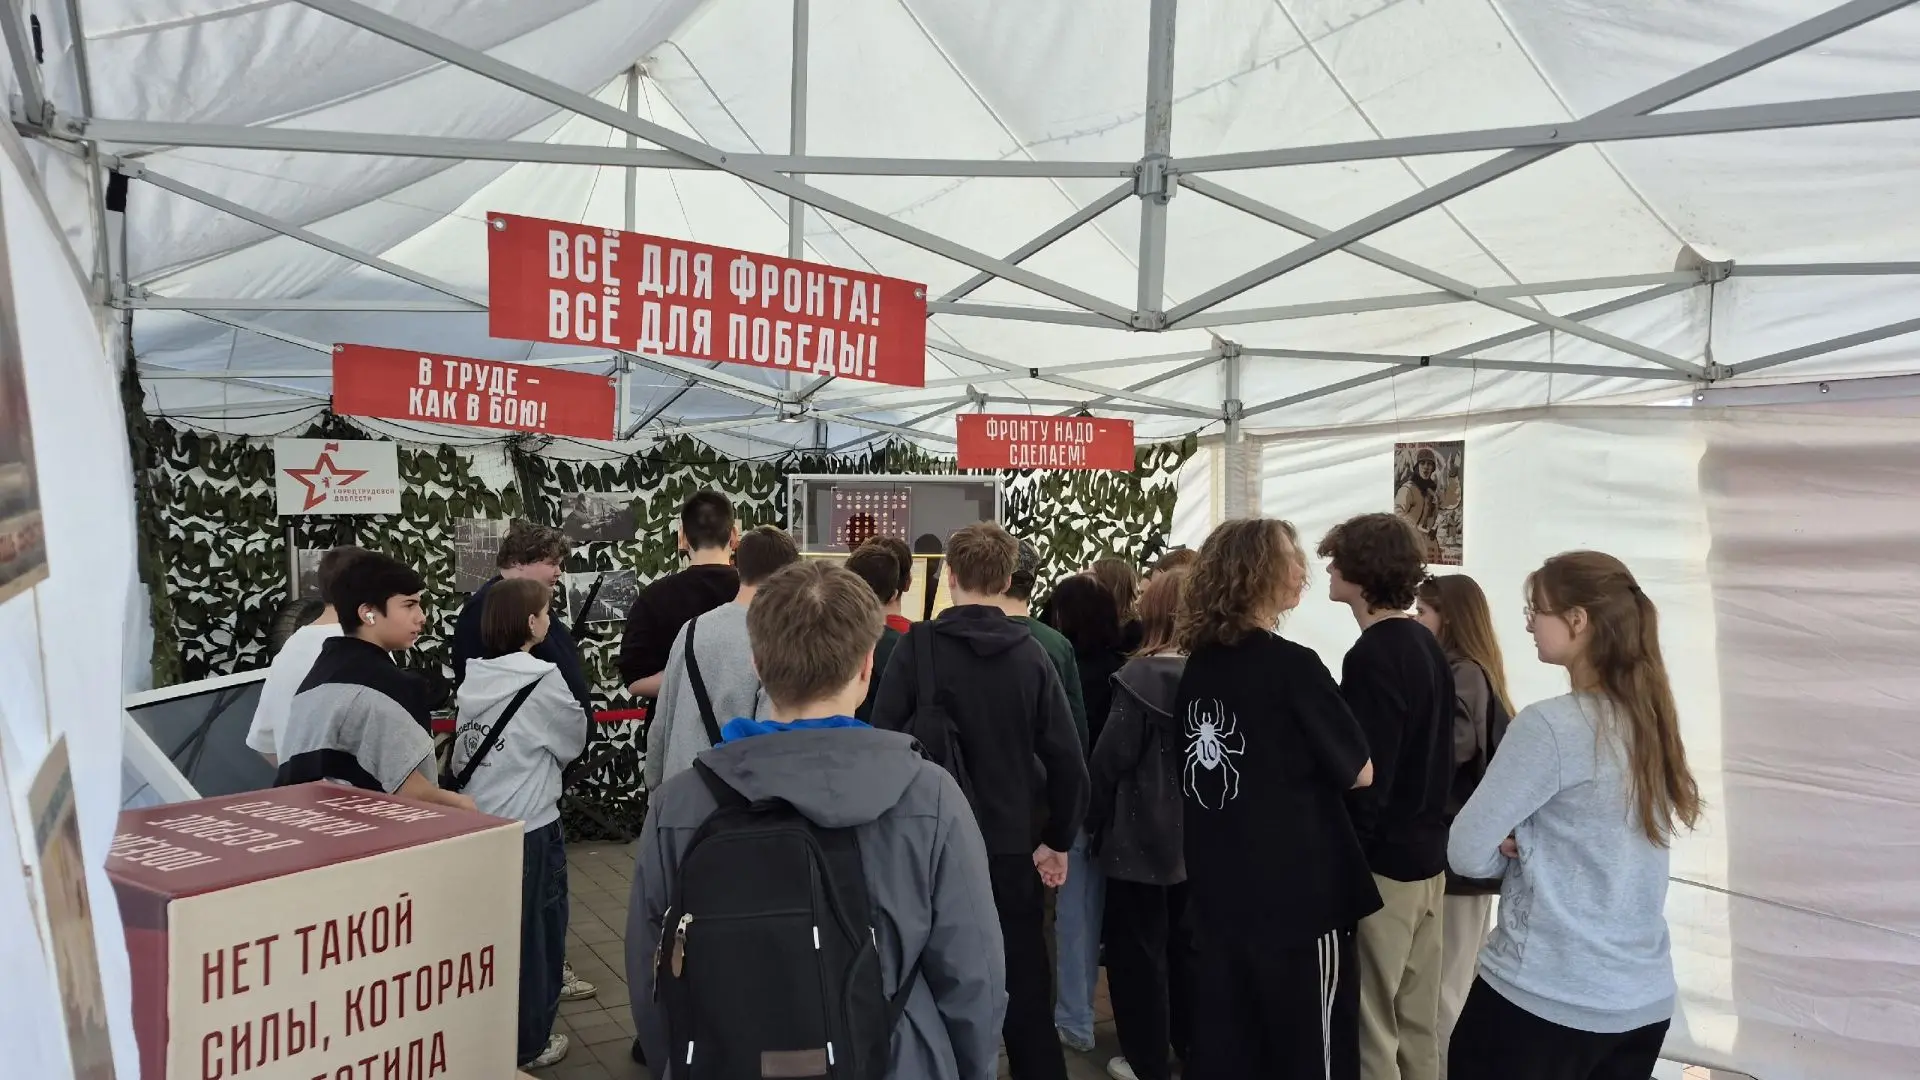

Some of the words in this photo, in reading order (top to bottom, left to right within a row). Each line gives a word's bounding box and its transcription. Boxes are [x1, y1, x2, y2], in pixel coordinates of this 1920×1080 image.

[548, 228, 621, 287] ВСЁ
[637, 243, 713, 299] ДЛЯ
[729, 254, 881, 327] ФРОНТА!
[548, 286, 621, 345] ВСЁ
[636, 300, 712, 355] ДЛЯ
[728, 312, 878, 379] ПОБЕДЫ!
[418, 357, 432, 386] В
[442, 360, 519, 397] ТРУДЕ
[408, 387, 458, 420] КАК
[466, 393, 480, 421] В
[489, 396, 547, 429] БОЮ!
[986, 417, 1049, 442] ФРОНТУ
[1054, 420, 1094, 445] НАДО
[1009, 444, 1086, 468] СДЕЛАЕМ!
[1200, 739, 1217, 762] 10
[222, 800, 380, 836] КАЖДОГО
[316, 795, 446, 823] ЖИВЁТ!
[145, 814, 279, 846] СЕРДЦЕ
[246, 839, 304, 853] В
[202, 933, 279, 1004] НЕТ
[294, 892, 412, 975] ТАКОЙ
[202, 1000, 330, 1080] СИЛЫ,
[345, 944, 494, 1037] КОТОРАЯ
